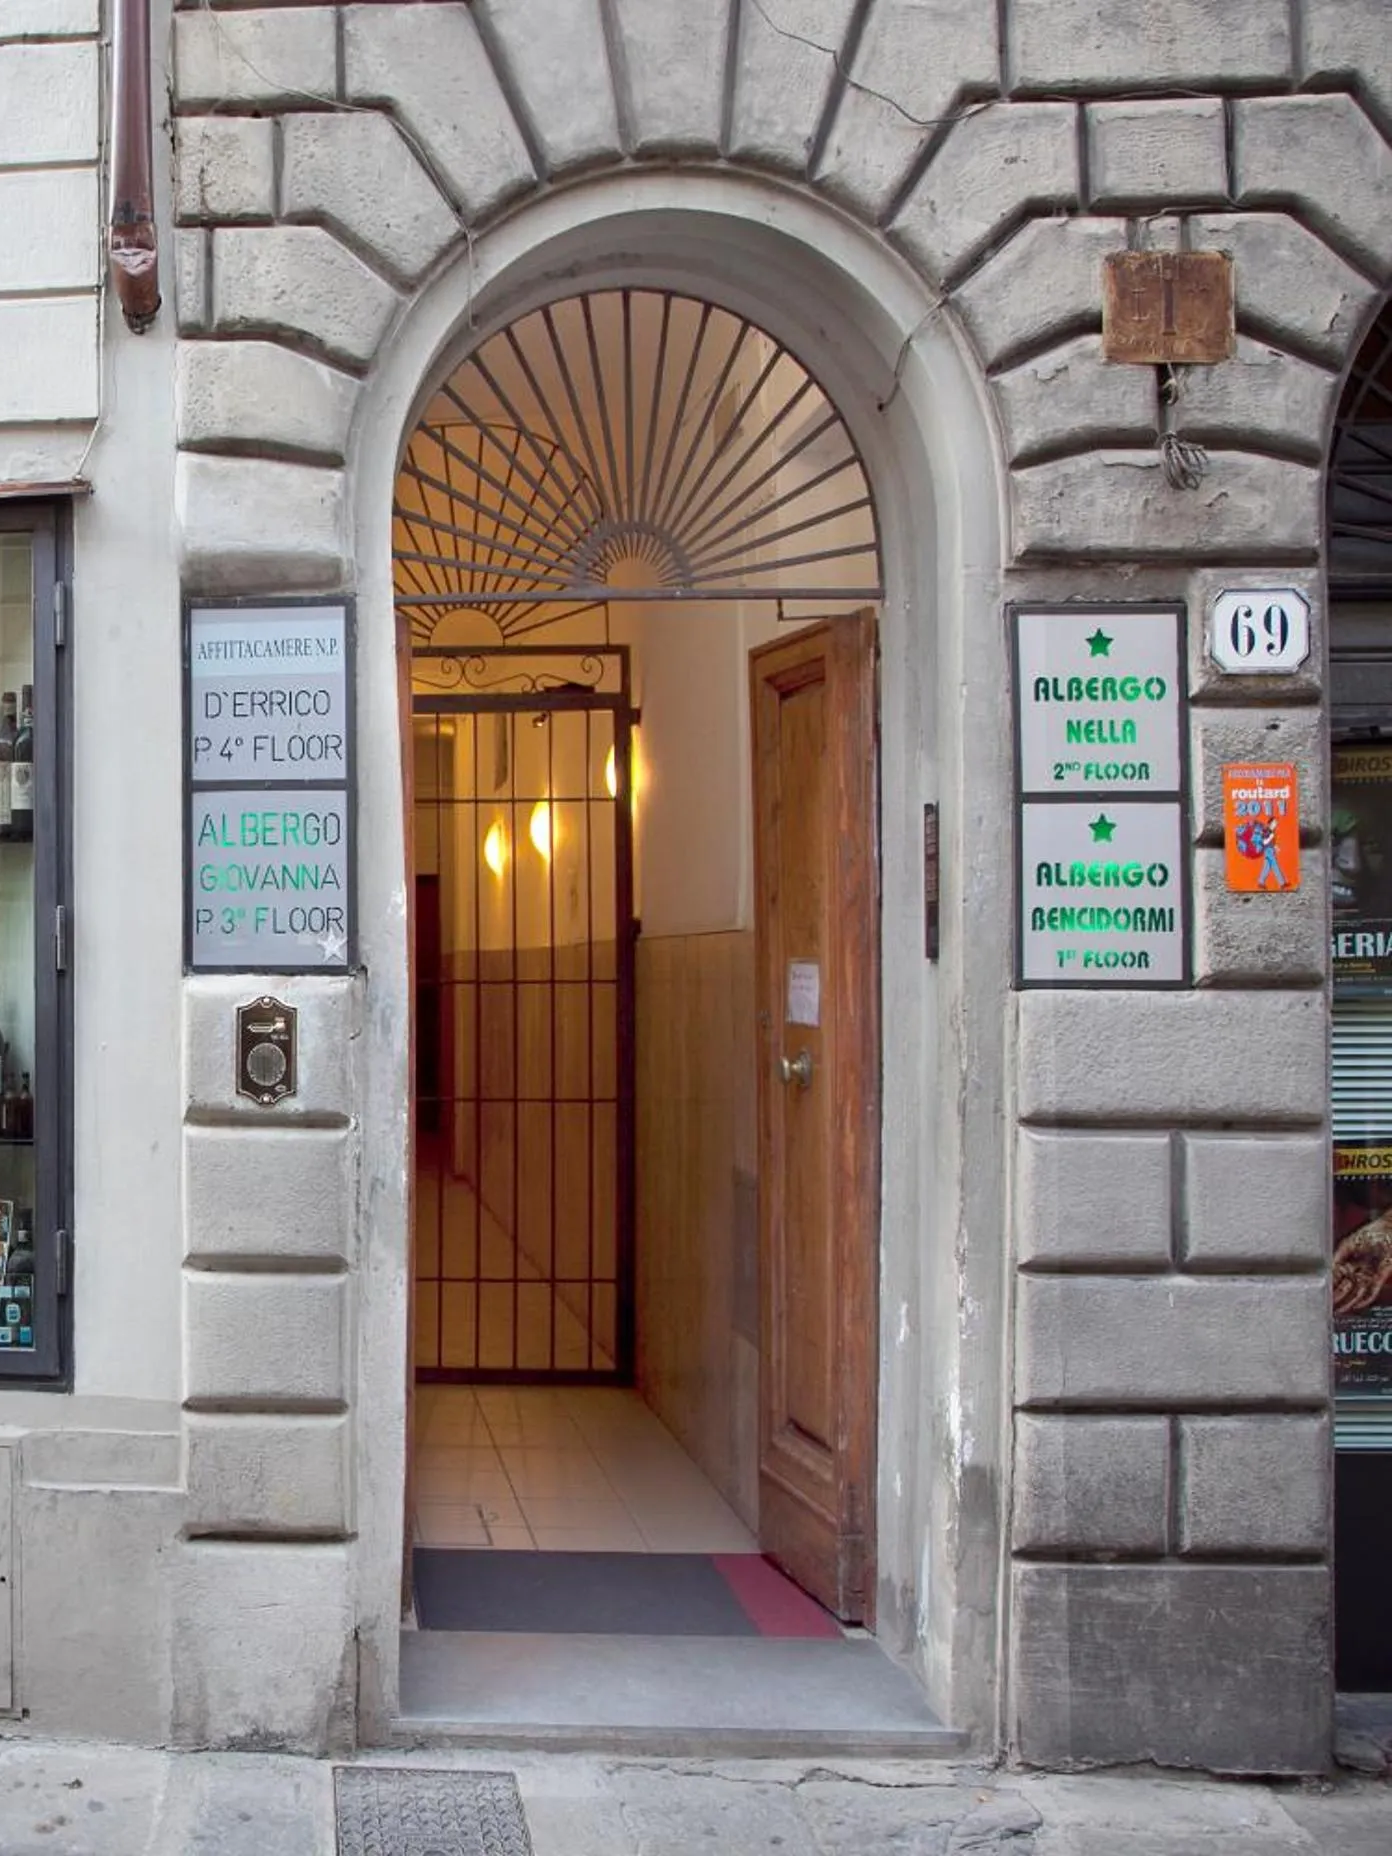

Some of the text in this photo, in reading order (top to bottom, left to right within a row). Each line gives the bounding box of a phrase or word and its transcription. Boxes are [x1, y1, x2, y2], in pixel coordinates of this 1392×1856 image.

[1230, 604, 1289, 657] 69
[197, 637, 339, 661] AFFITTACAMERE N.P.
[1033, 676, 1167, 702] ALBERGO
[1065, 719, 1137, 743] NELLA
[194, 736, 212, 764] P.
[253, 733, 343, 762] FLOOR
[1053, 760, 1150, 781] 2ND FLOOR
[1231, 785, 1291, 799] routard
[1236, 800, 1287, 816] 2011
[197, 812, 342, 848] ALBERGO
[1036, 861, 1169, 887] ALBERGO
[195, 908, 214, 935] P.
[255, 906, 345, 935] FLOOR
[1031, 906, 1174, 933] BENCIDORMI
[1083, 949, 1150, 969] FLOOR
